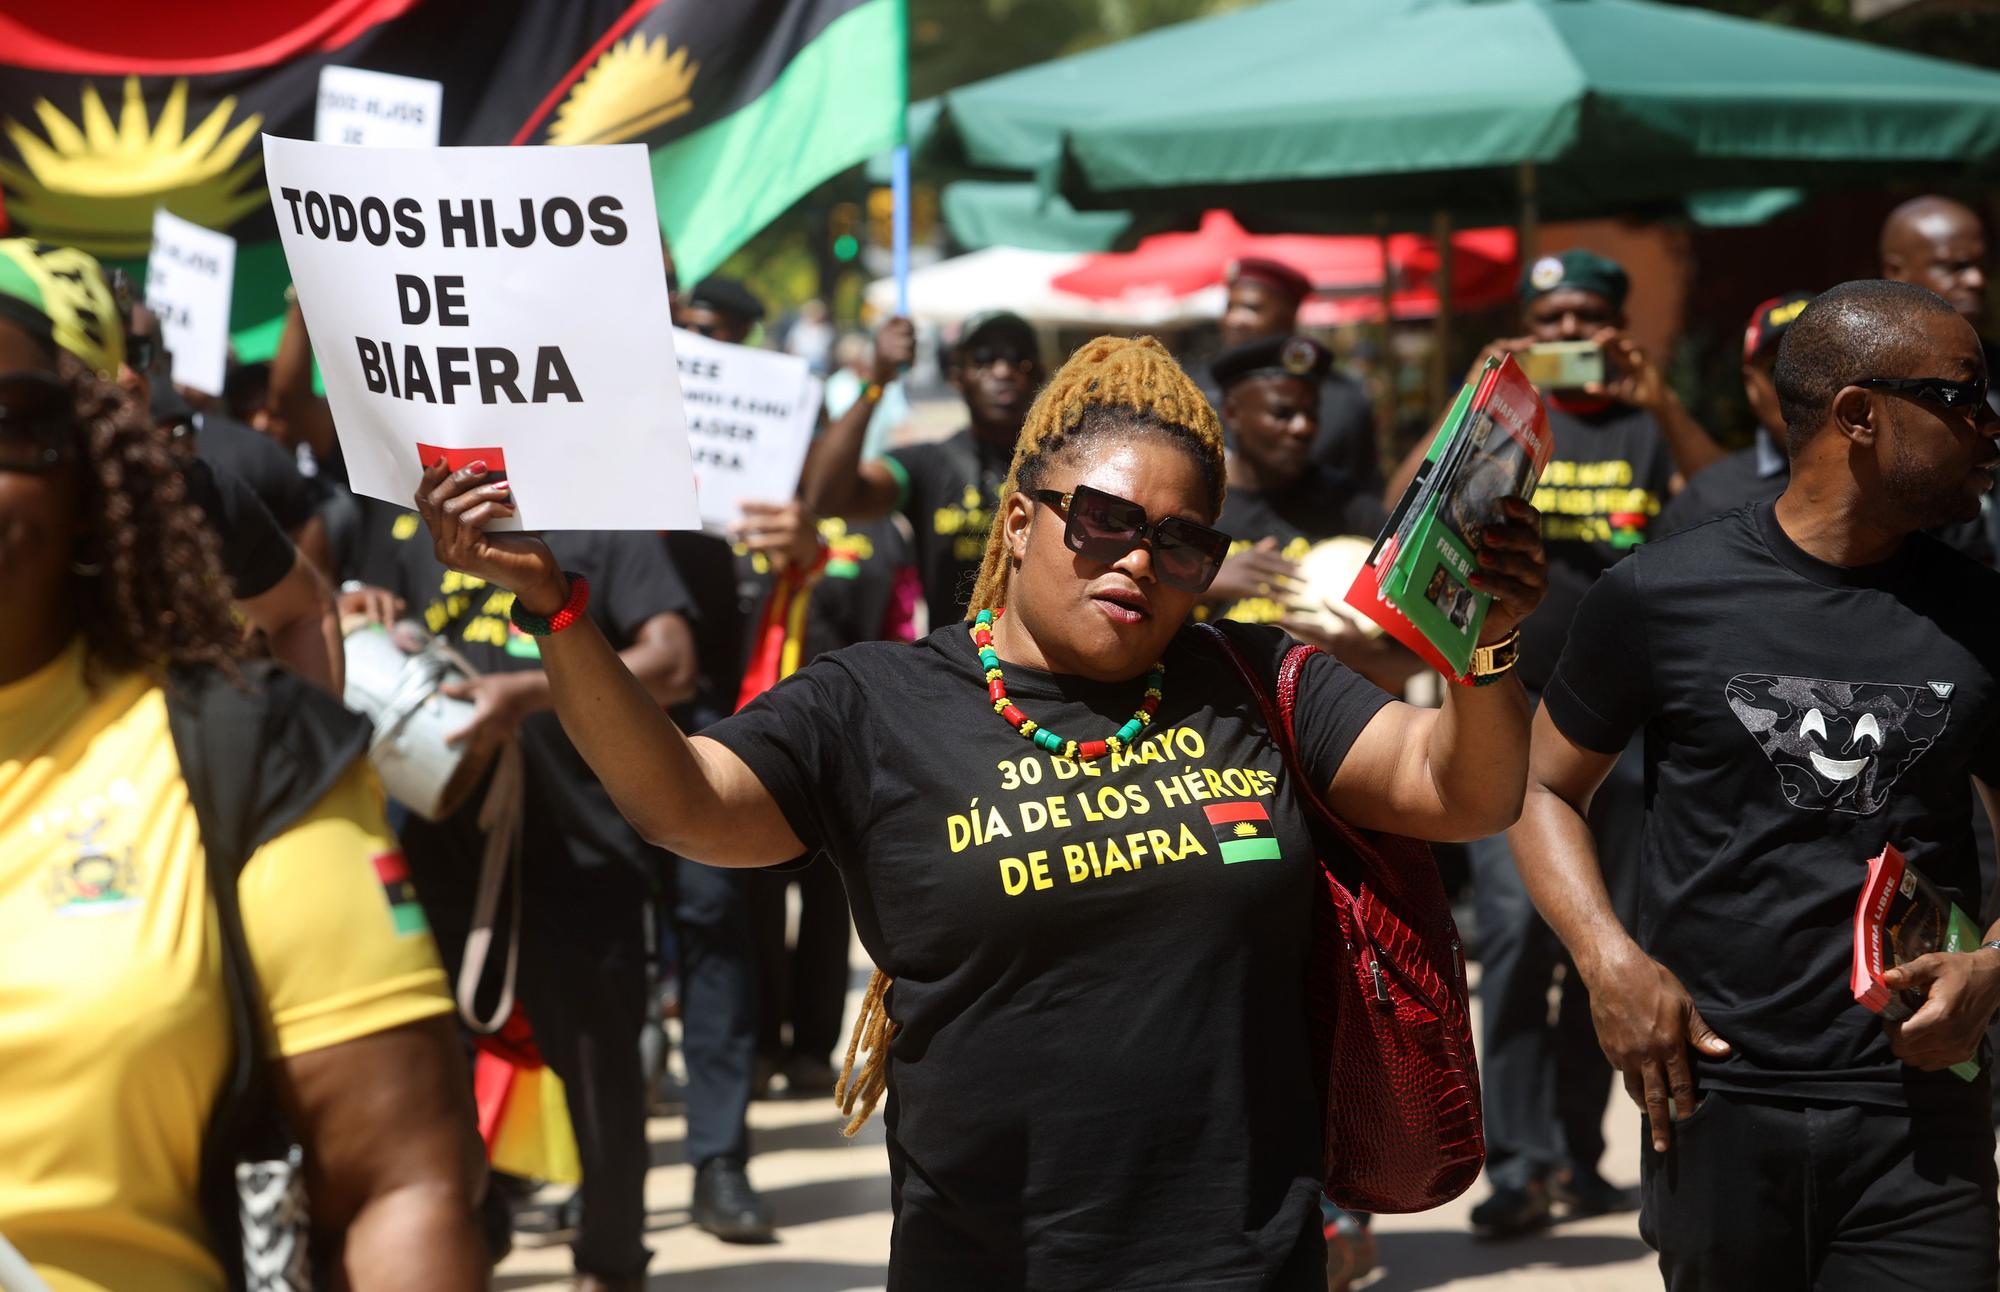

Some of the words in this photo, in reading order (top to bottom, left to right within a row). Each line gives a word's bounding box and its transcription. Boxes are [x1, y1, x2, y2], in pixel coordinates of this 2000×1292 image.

[281, 186, 426, 249] TODOS
[438, 195, 628, 248] HIJOS
[395, 273, 469, 327] DE
[355, 336, 584, 405] BIAFRA
[676, 357, 721, 379] REE
[1436, 536, 1458, 566] FREE
[997, 756, 1043, 791] 30
[1050, 754, 1102, 780] DE
[1111, 726, 1206, 773] MAYO
[947, 797, 1012, 853] DÍA
[1019, 796, 1072, 833] DE
[1077, 784, 1150, 822] LOS
[1155, 765, 1278, 809] HÉROES
[1000, 850, 1054, 896] DE
[1062, 823, 1208, 884] BIAFRA
[1874, 876, 1895, 921] LIBRE
[1871, 924, 1881, 976] BIAFRA
